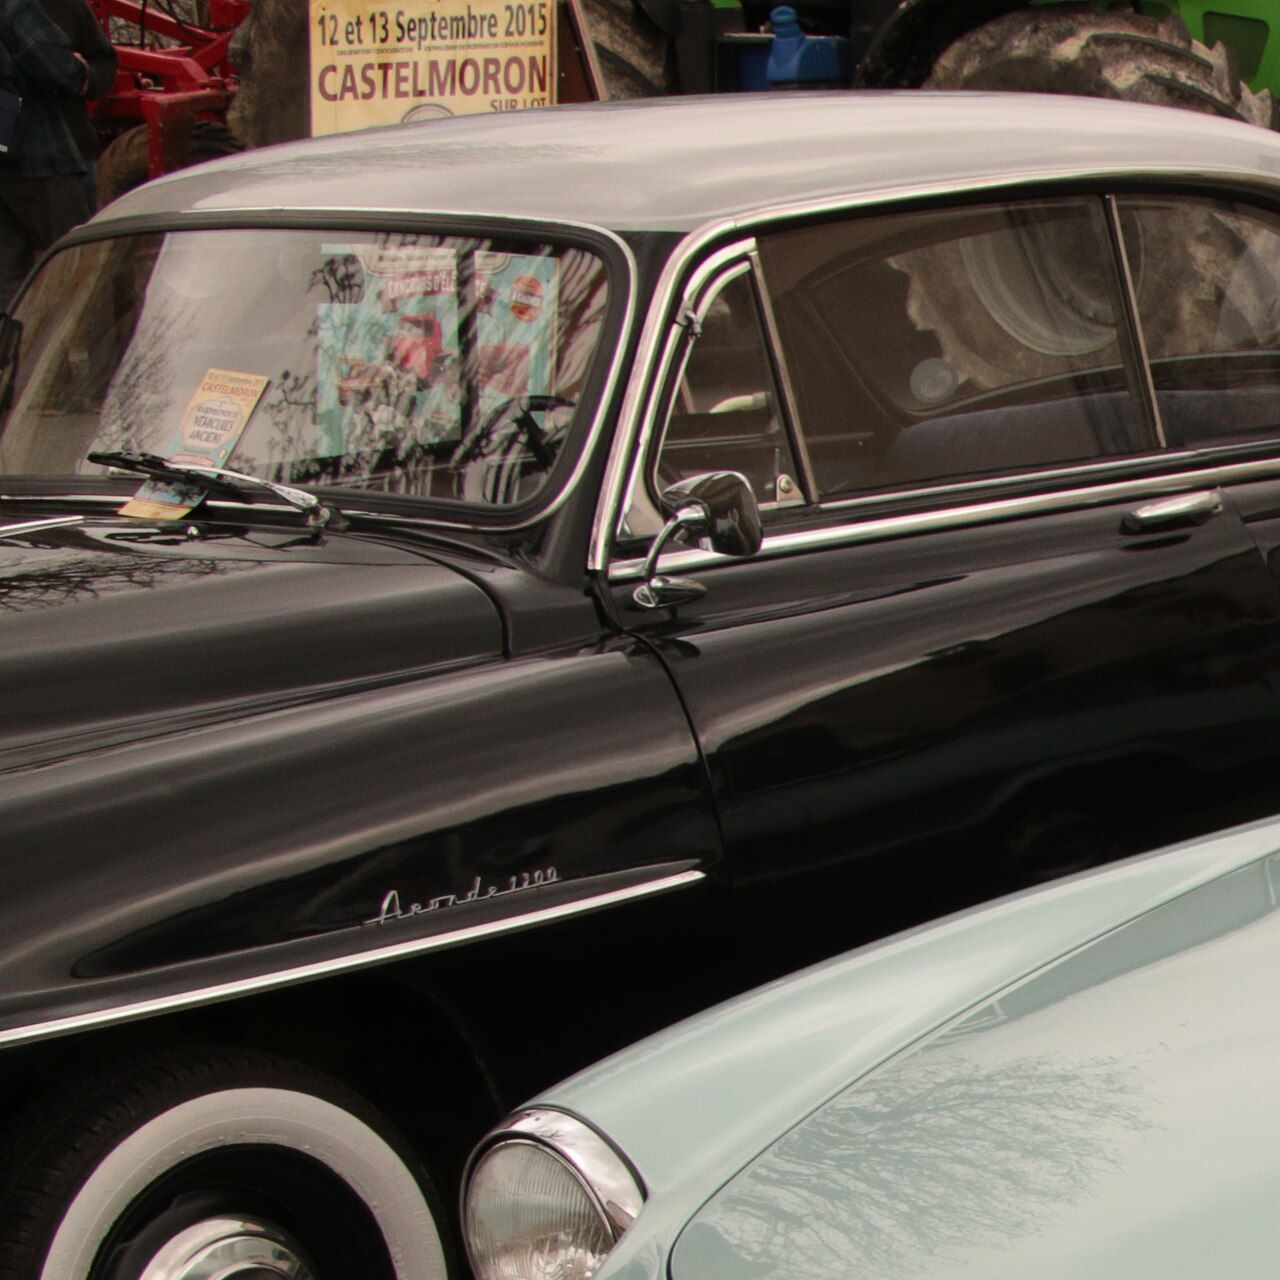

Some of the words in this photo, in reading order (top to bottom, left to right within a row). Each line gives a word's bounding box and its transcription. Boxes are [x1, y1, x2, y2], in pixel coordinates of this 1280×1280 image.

[318, 14, 339, 46] 12
[345, 15, 363, 45] et
[369, 11, 389, 44] 13
[395, 5, 498, 50] Septembre
[505, 3, 547, 37] 2015
[318, 55, 547, 102] CASTELMORON
